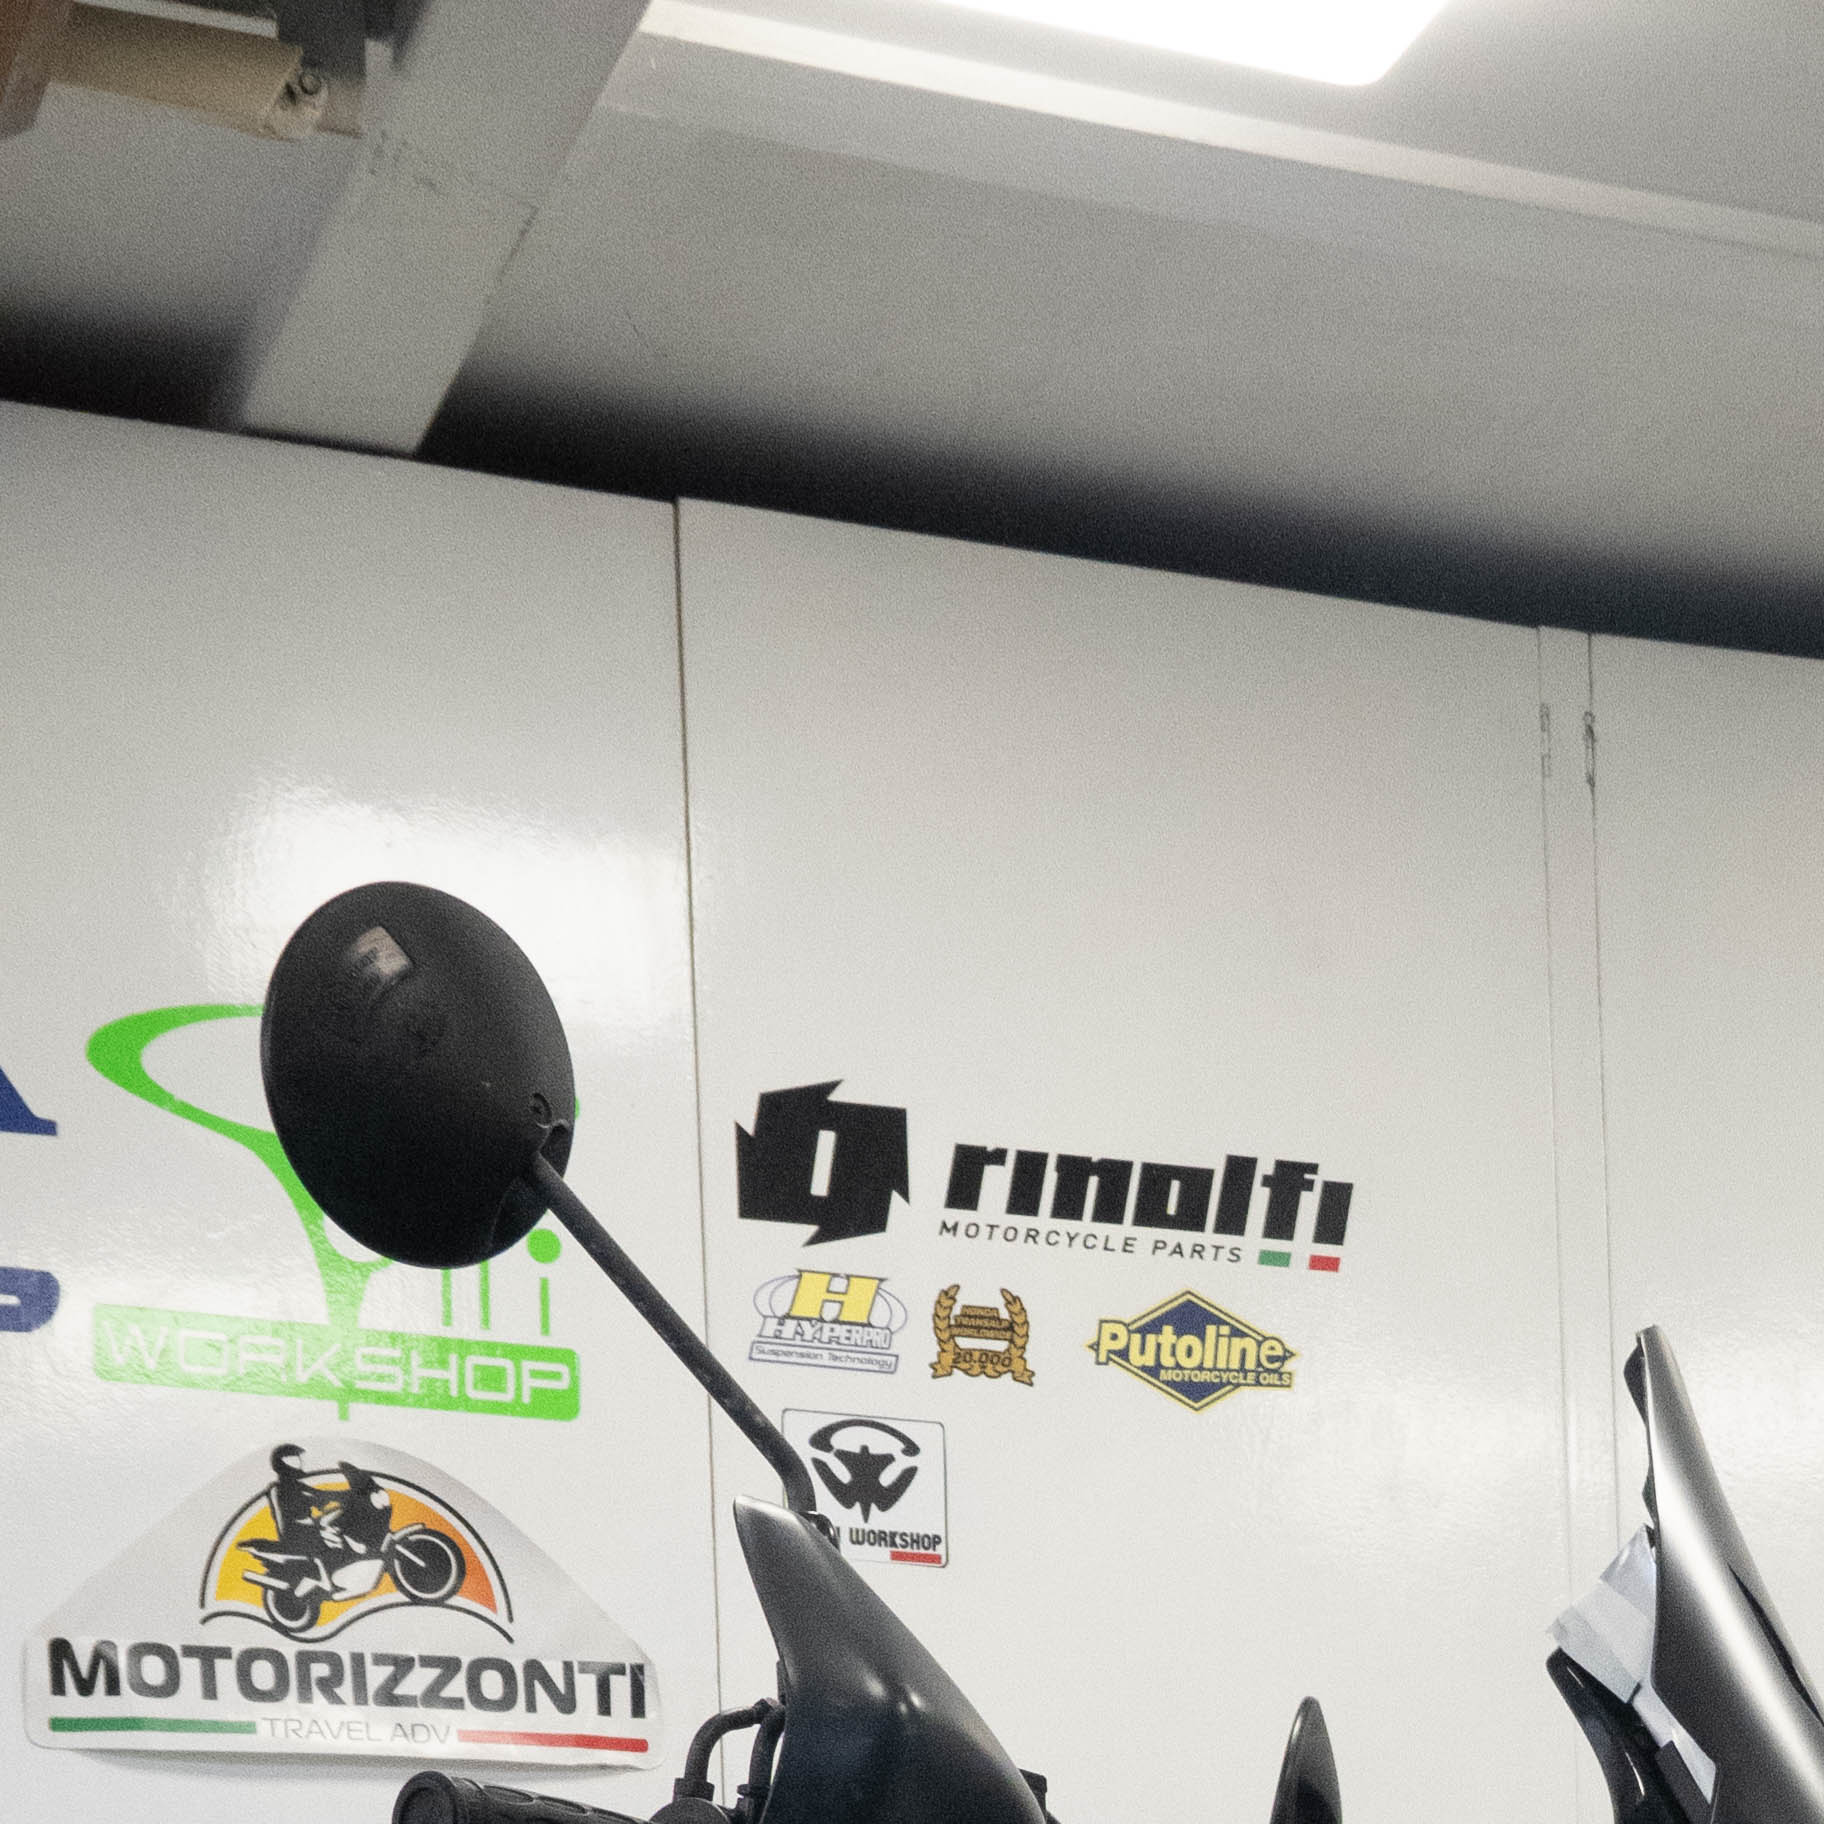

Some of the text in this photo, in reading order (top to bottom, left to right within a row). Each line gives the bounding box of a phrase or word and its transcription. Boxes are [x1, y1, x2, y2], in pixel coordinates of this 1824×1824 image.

[938, 1219, 1243, 1264] MOTORCYCLE PARTS
[758, 1316, 893, 1349] HYPERPRO
[1097, 1320, 1285, 1370] Putoline
[102, 1318, 571, 1404] WORKSHOP
[755, 1345, 893, 1370] Suspension Technology
[1159, 1369, 1290, 1385] MOTORCYCLE OILS
[849, 1527, 942, 1552] WORKSHOP
[49, 1636, 647, 1719] MOTORIZZONTI
[261, 1717, 452, 1744] TRAVEL ADV
